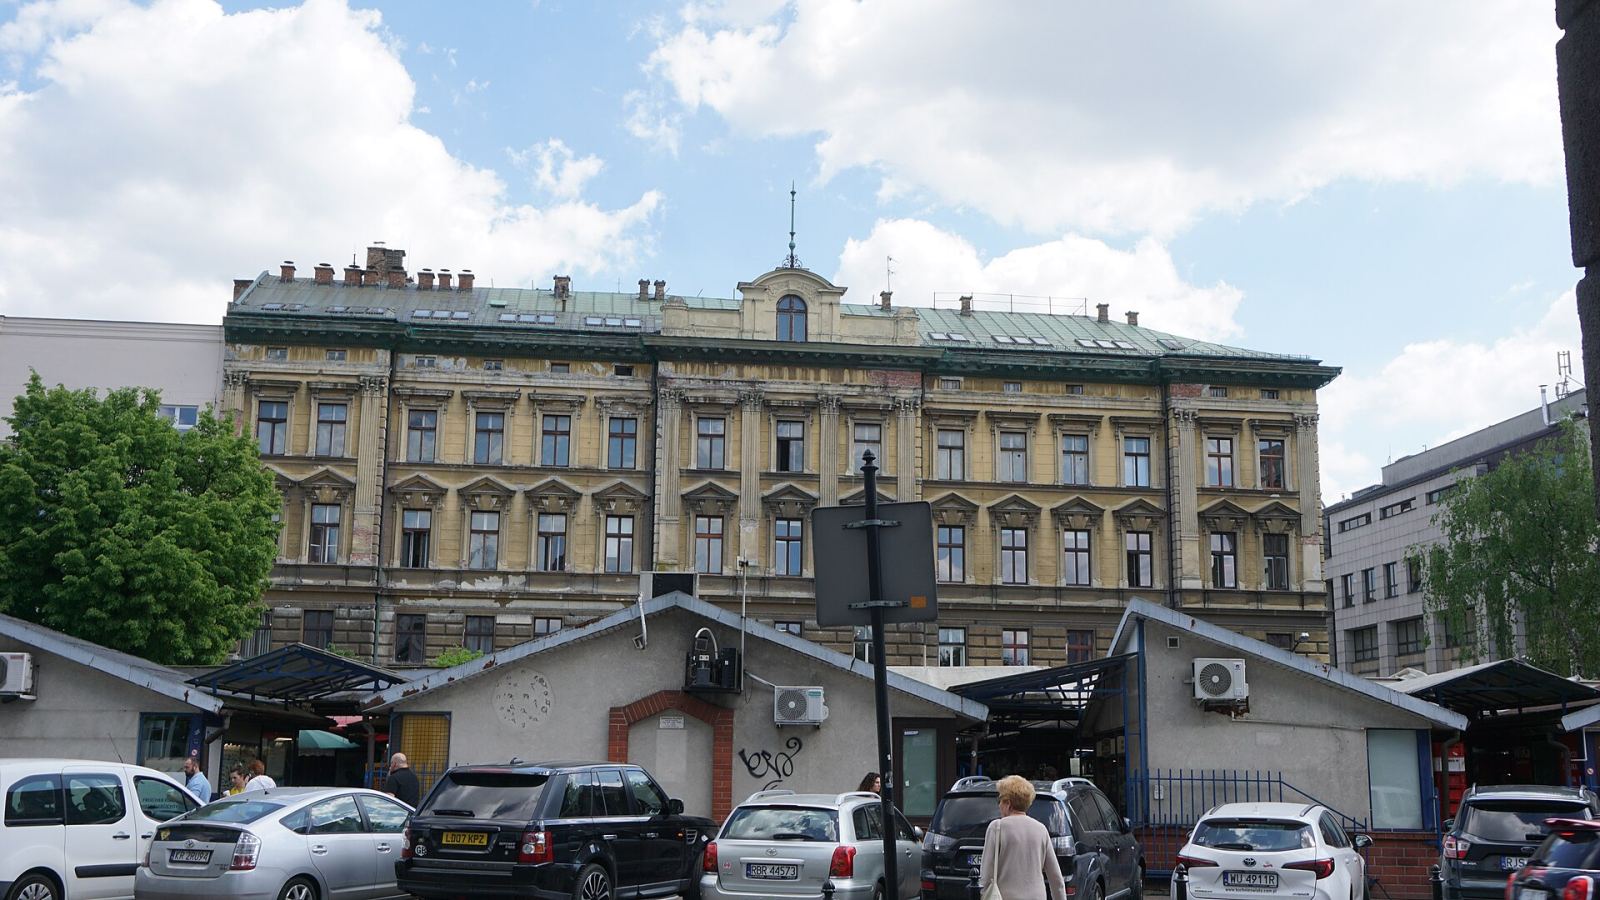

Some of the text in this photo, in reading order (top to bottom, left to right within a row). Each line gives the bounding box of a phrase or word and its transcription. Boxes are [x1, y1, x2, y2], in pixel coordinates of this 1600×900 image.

[467, 834, 485, 844] KPZ
[174, 851, 185, 860] KR
[1506, 857, 1525, 868] RJS
[751, 865, 796, 876] RBR 44573
[1229, 873, 1275, 885] WU 4911R
